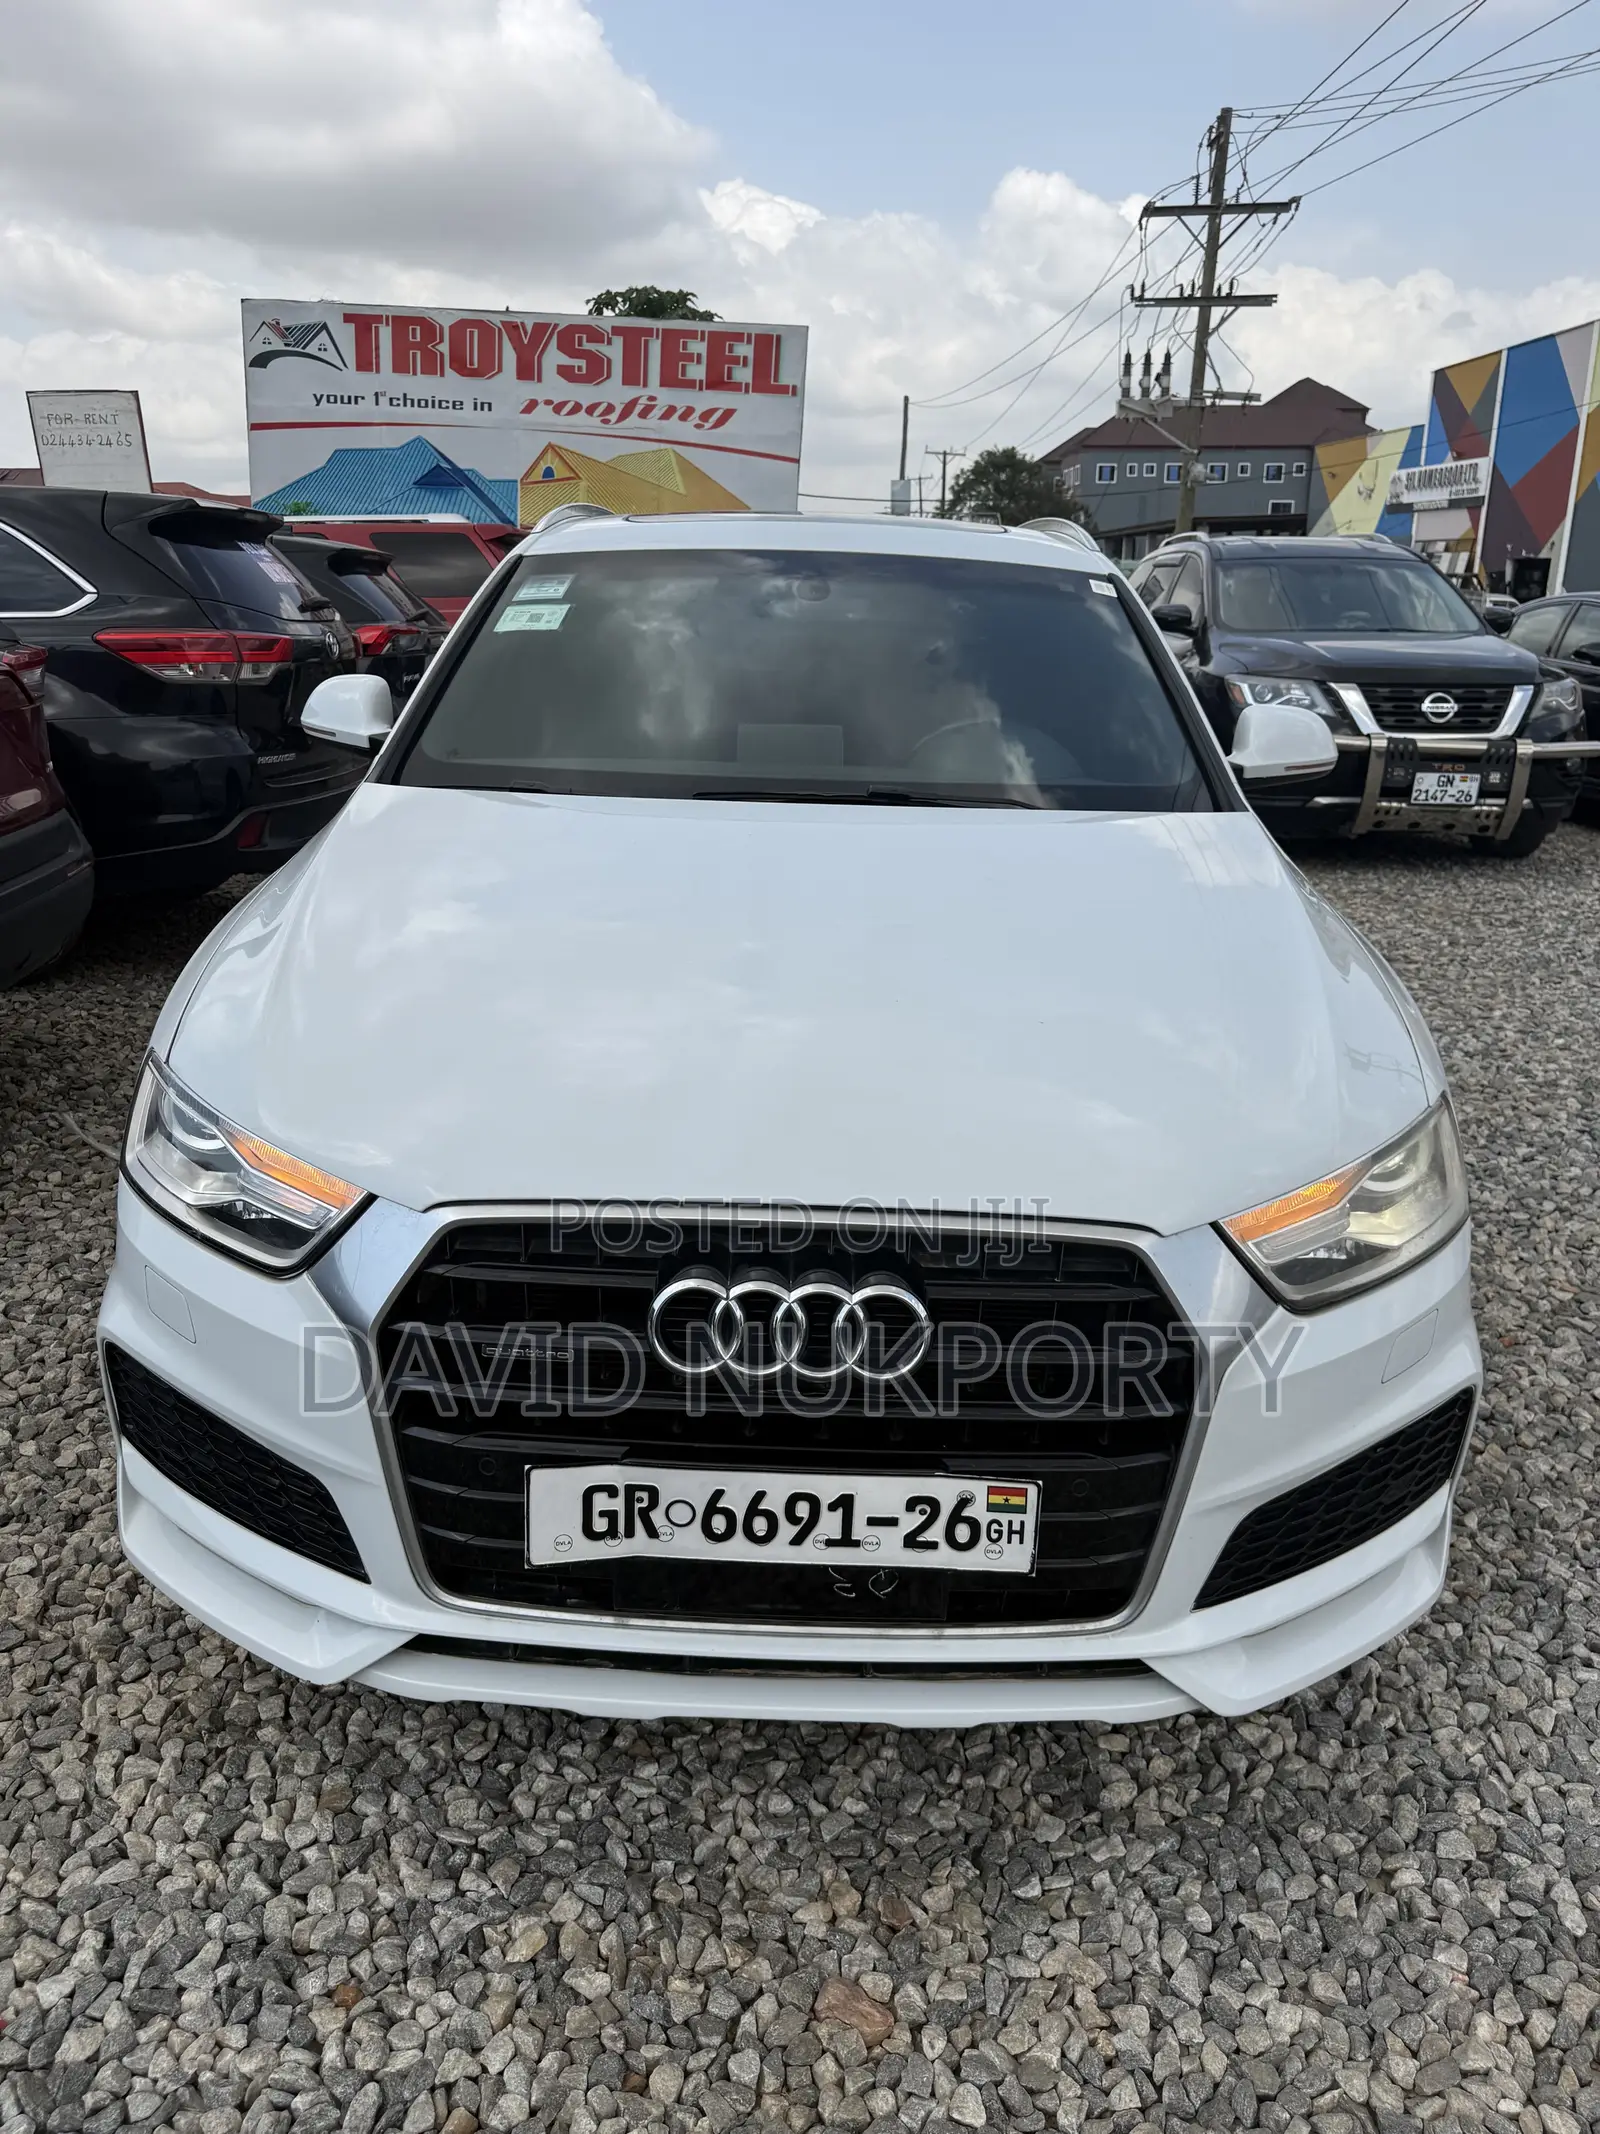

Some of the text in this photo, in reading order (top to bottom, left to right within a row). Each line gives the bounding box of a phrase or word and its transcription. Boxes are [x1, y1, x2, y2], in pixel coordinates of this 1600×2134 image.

[342, 312, 797, 397] TROYSTEEL
[312, 393, 365, 407] your
[388, 393, 464, 411] choice
[473, 397, 493, 412] in
[520, 394, 738, 430] roofing
[1437, 774, 1456, 788] GN
[1413, 788, 1474, 804] 2147-26
[486, 1346, 570, 1359] quattro
[581, 1483, 1026, 1552] GR 6691-26 GH
